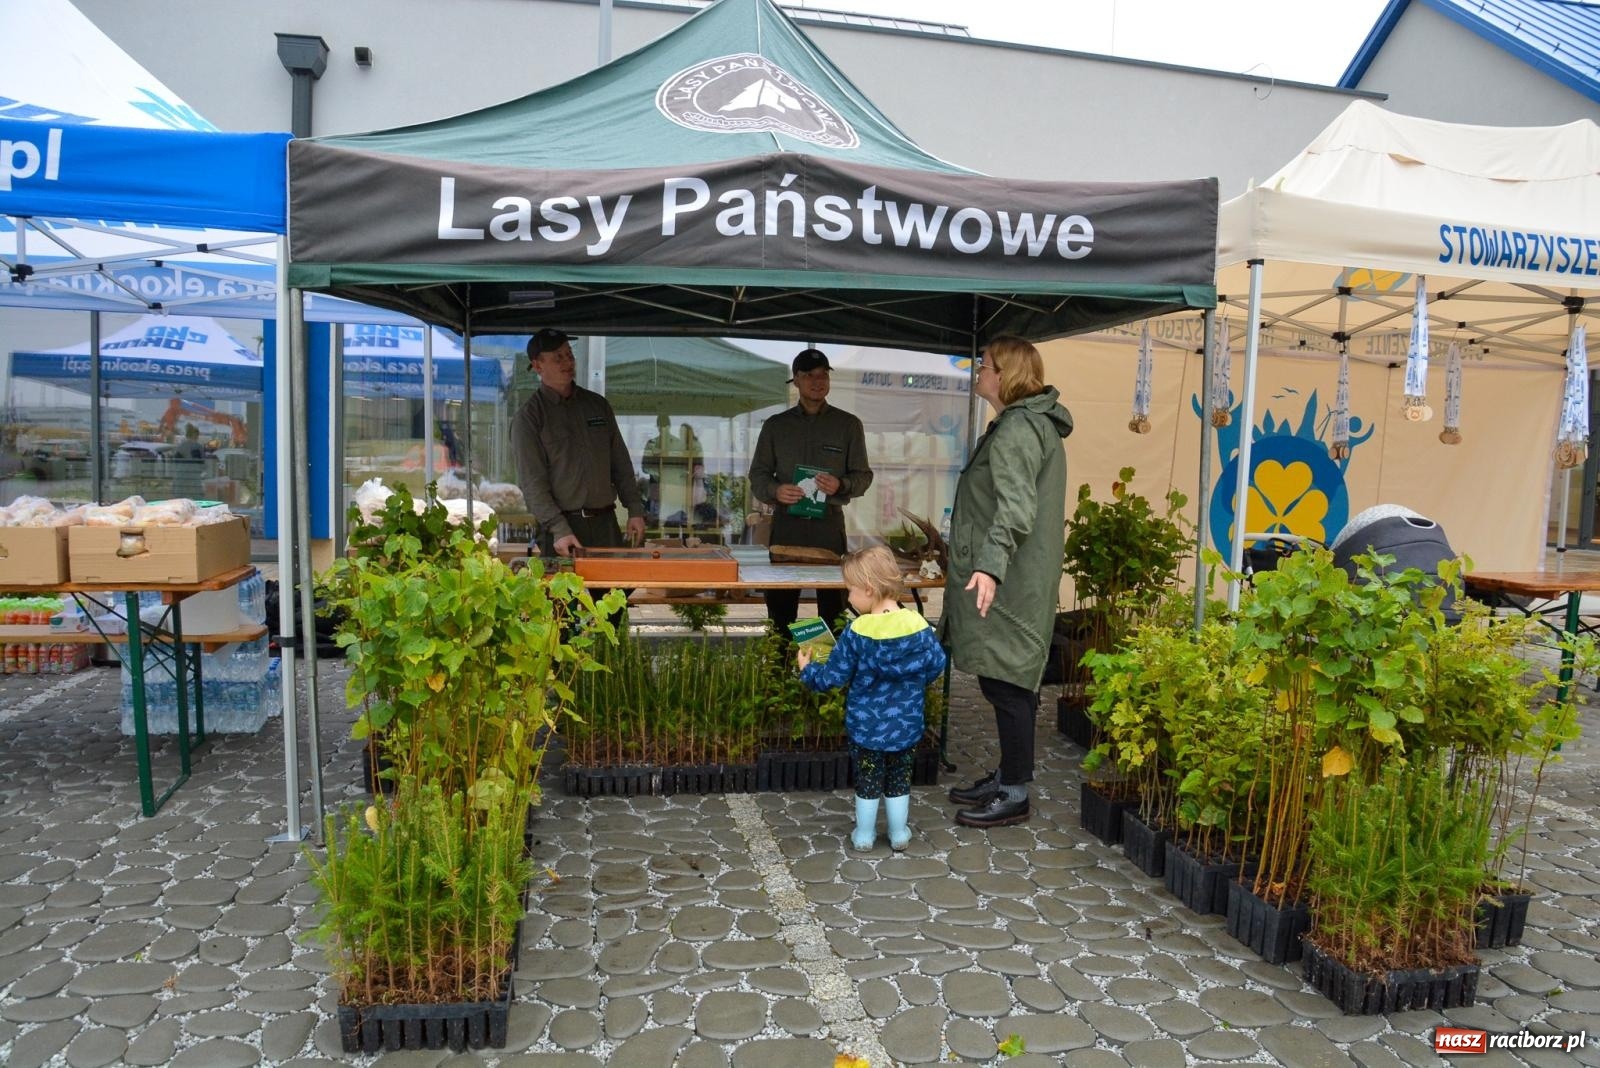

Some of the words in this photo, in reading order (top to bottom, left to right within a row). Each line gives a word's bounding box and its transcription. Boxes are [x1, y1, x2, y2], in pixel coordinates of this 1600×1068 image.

[673, 70, 708, 101] LASY
[438, 177, 632, 256] Lasy
[662, 172, 1095, 260] Państwowe
[1439, 223, 1600, 276] STOWARZYSZE
